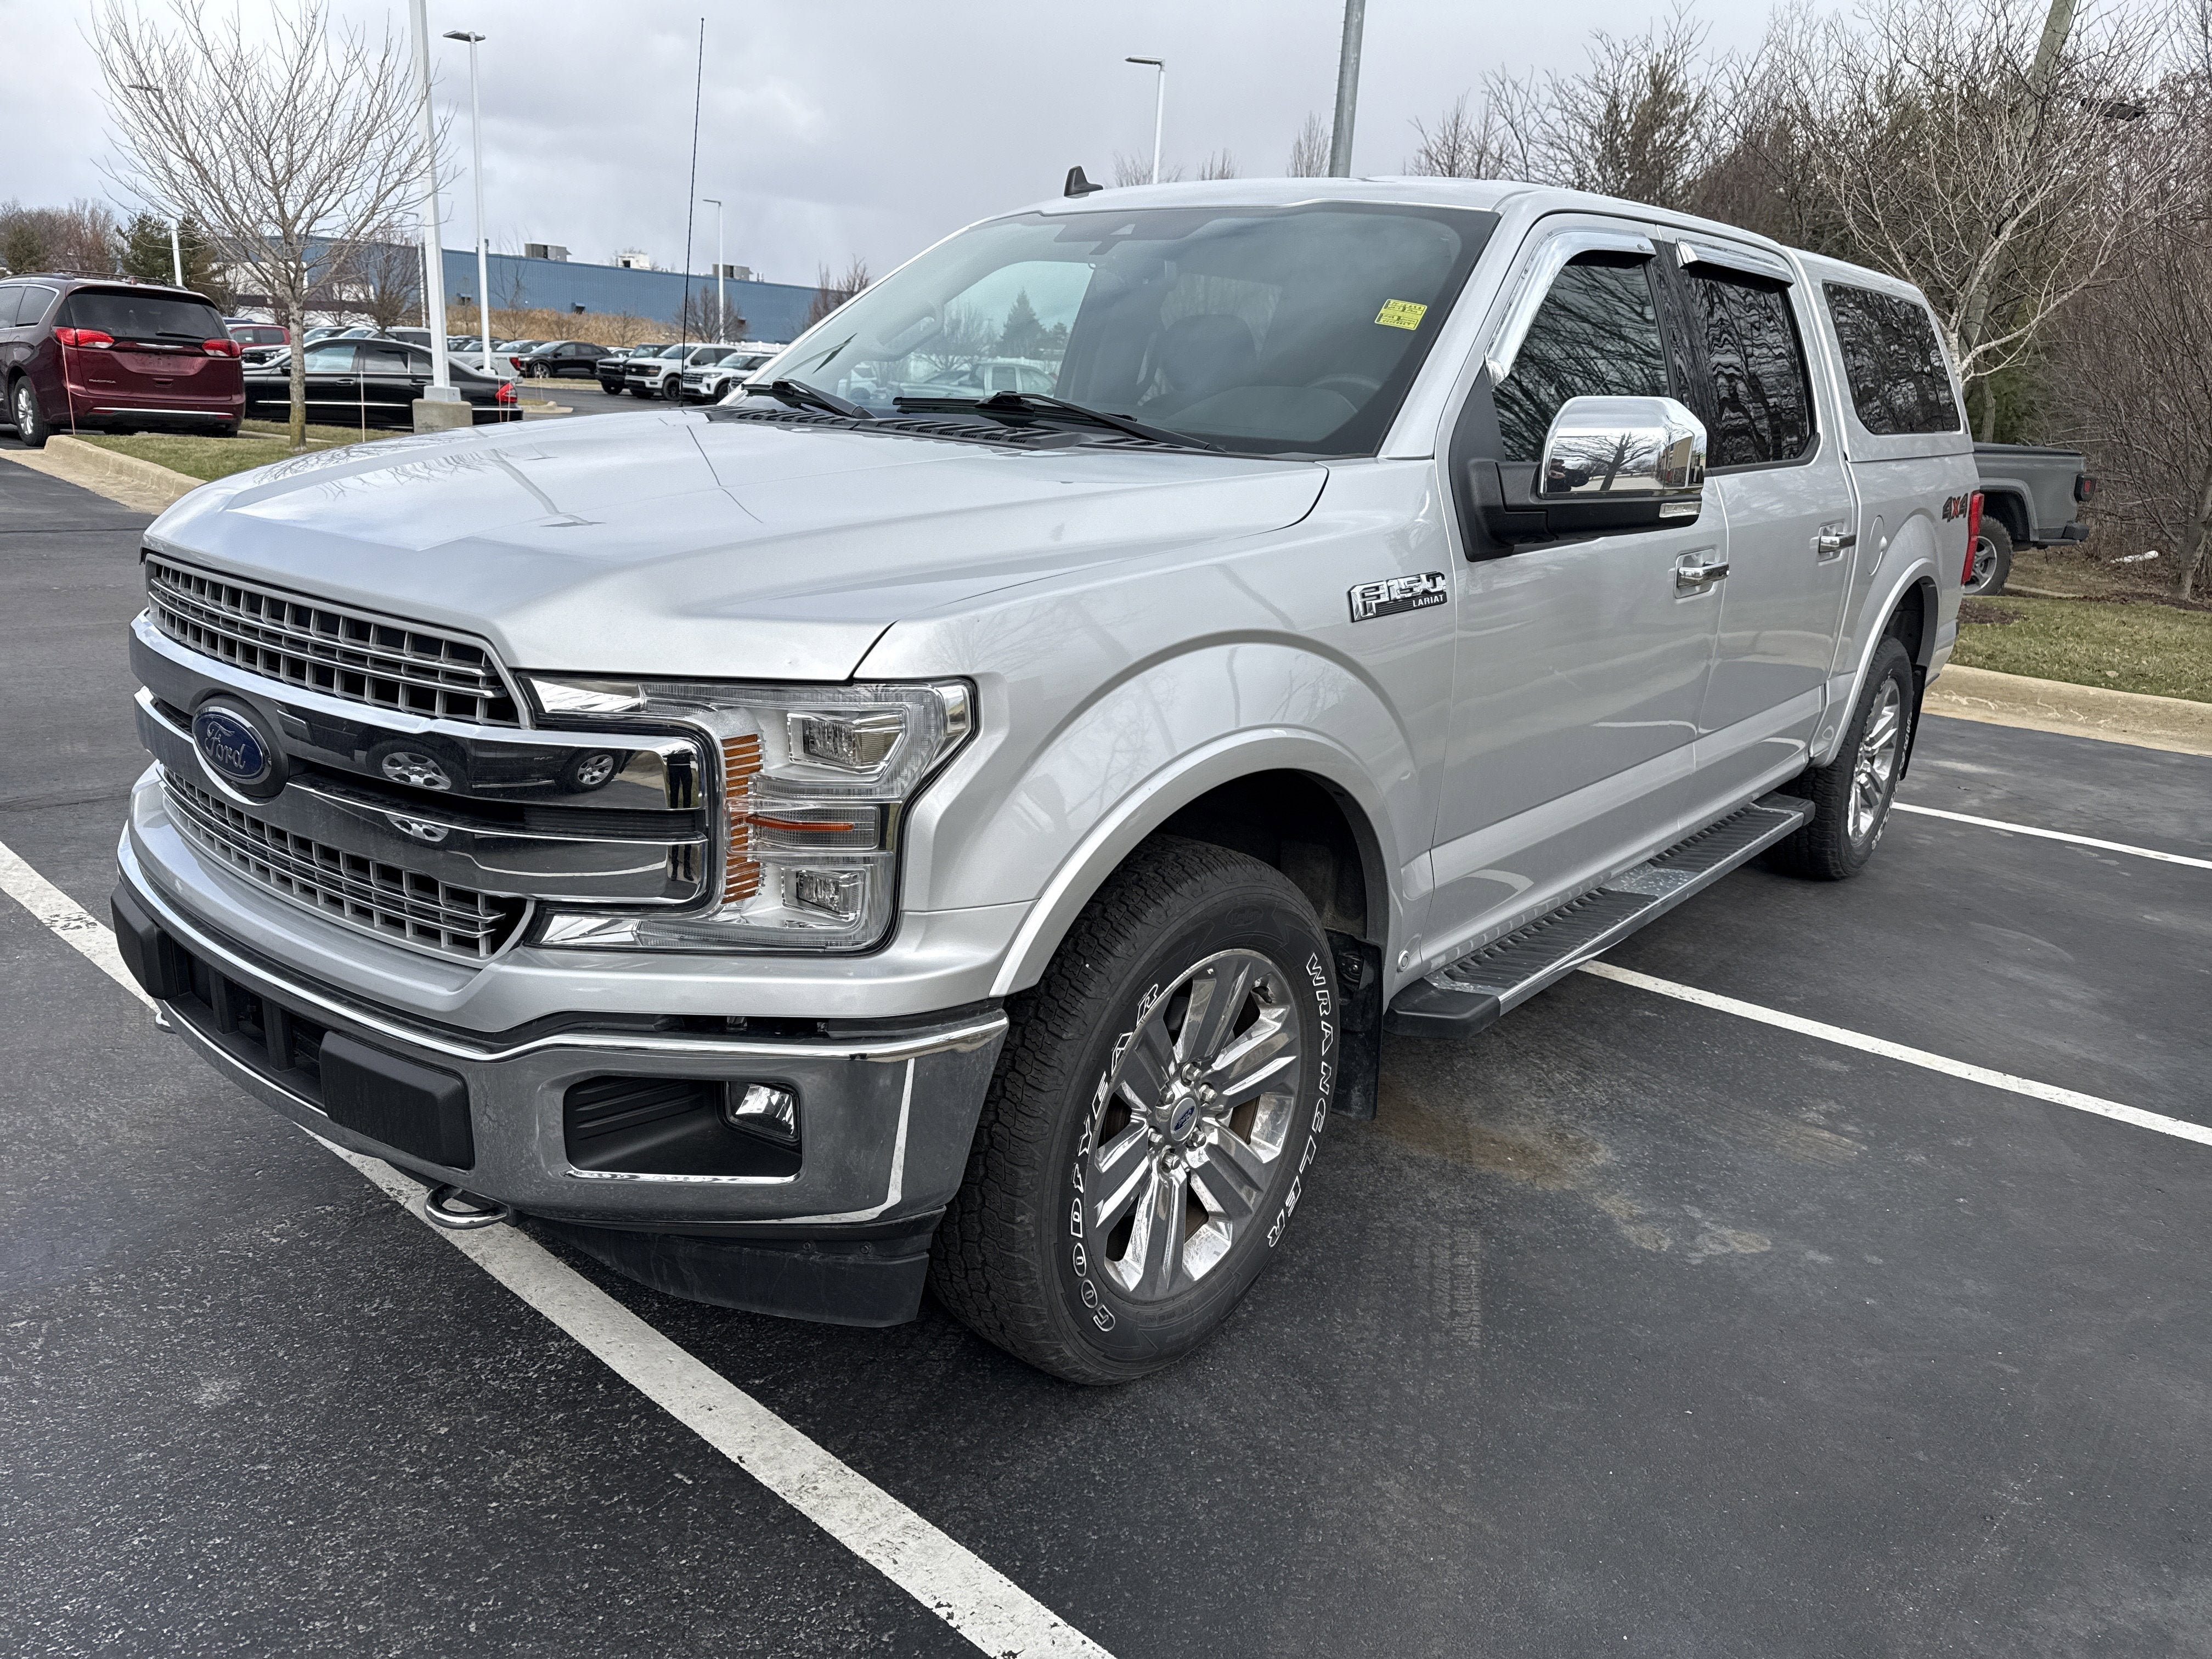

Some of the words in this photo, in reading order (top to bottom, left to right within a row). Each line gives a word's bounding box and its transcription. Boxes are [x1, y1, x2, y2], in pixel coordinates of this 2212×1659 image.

[1412, 594, 1444, 607] LARIAT
[204, 721, 246, 770] Ford
[1070, 984, 1158, 1332] GOODYEAR
[1267, 952, 1333, 1248] WRANGLER
